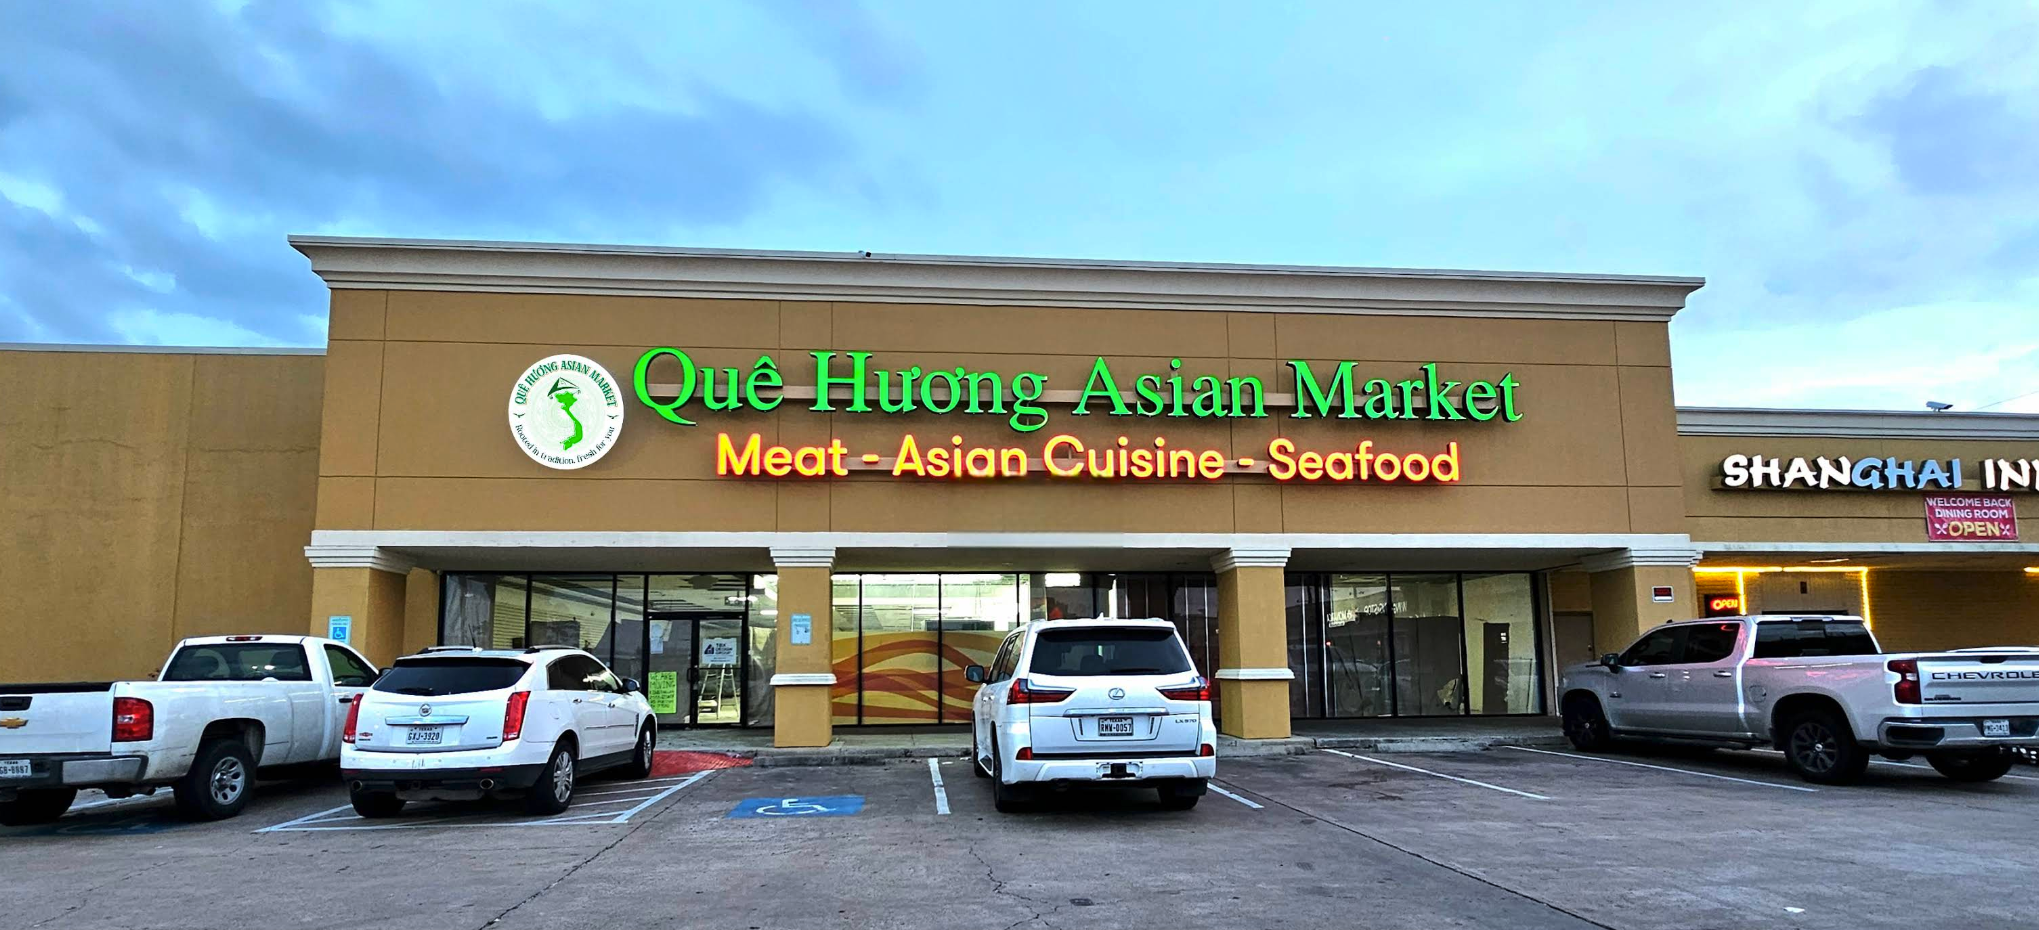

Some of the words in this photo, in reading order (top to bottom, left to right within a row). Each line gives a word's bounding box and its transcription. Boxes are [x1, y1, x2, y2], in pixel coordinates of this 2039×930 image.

[514, 383, 530, 405] QUÊ
[561, 360, 590, 375] ASIAN
[589, 370, 617, 407] MARKET
[634, 347, 783, 425] Quê
[810, 351, 1049, 432] Hương
[1073, 357, 1268, 418] Asian
[1287, 361, 1522, 422] Market
[515, 424, 534, 450] Rooted
[576, 449, 597, 463] fresh
[605, 426, 615, 442] you
[715, 432, 848, 478] Meat
[891, 433, 1029, 478] Asian
[1042, 433, 1226, 480] Cuisine
[1267, 437, 1461, 483] Seafood
[1722, 454, 1963, 491] SHANGHAI
[1926, 497, 1982, 507] WELCOME
[1983, 499, 2011, 508] BACK
[1935, 509, 1972, 519] DINING
[1974, 509, 2008, 519] ROOM
[1948, 521, 2000, 537] OPEN
[1712, 599, 1739, 611] OPEN
